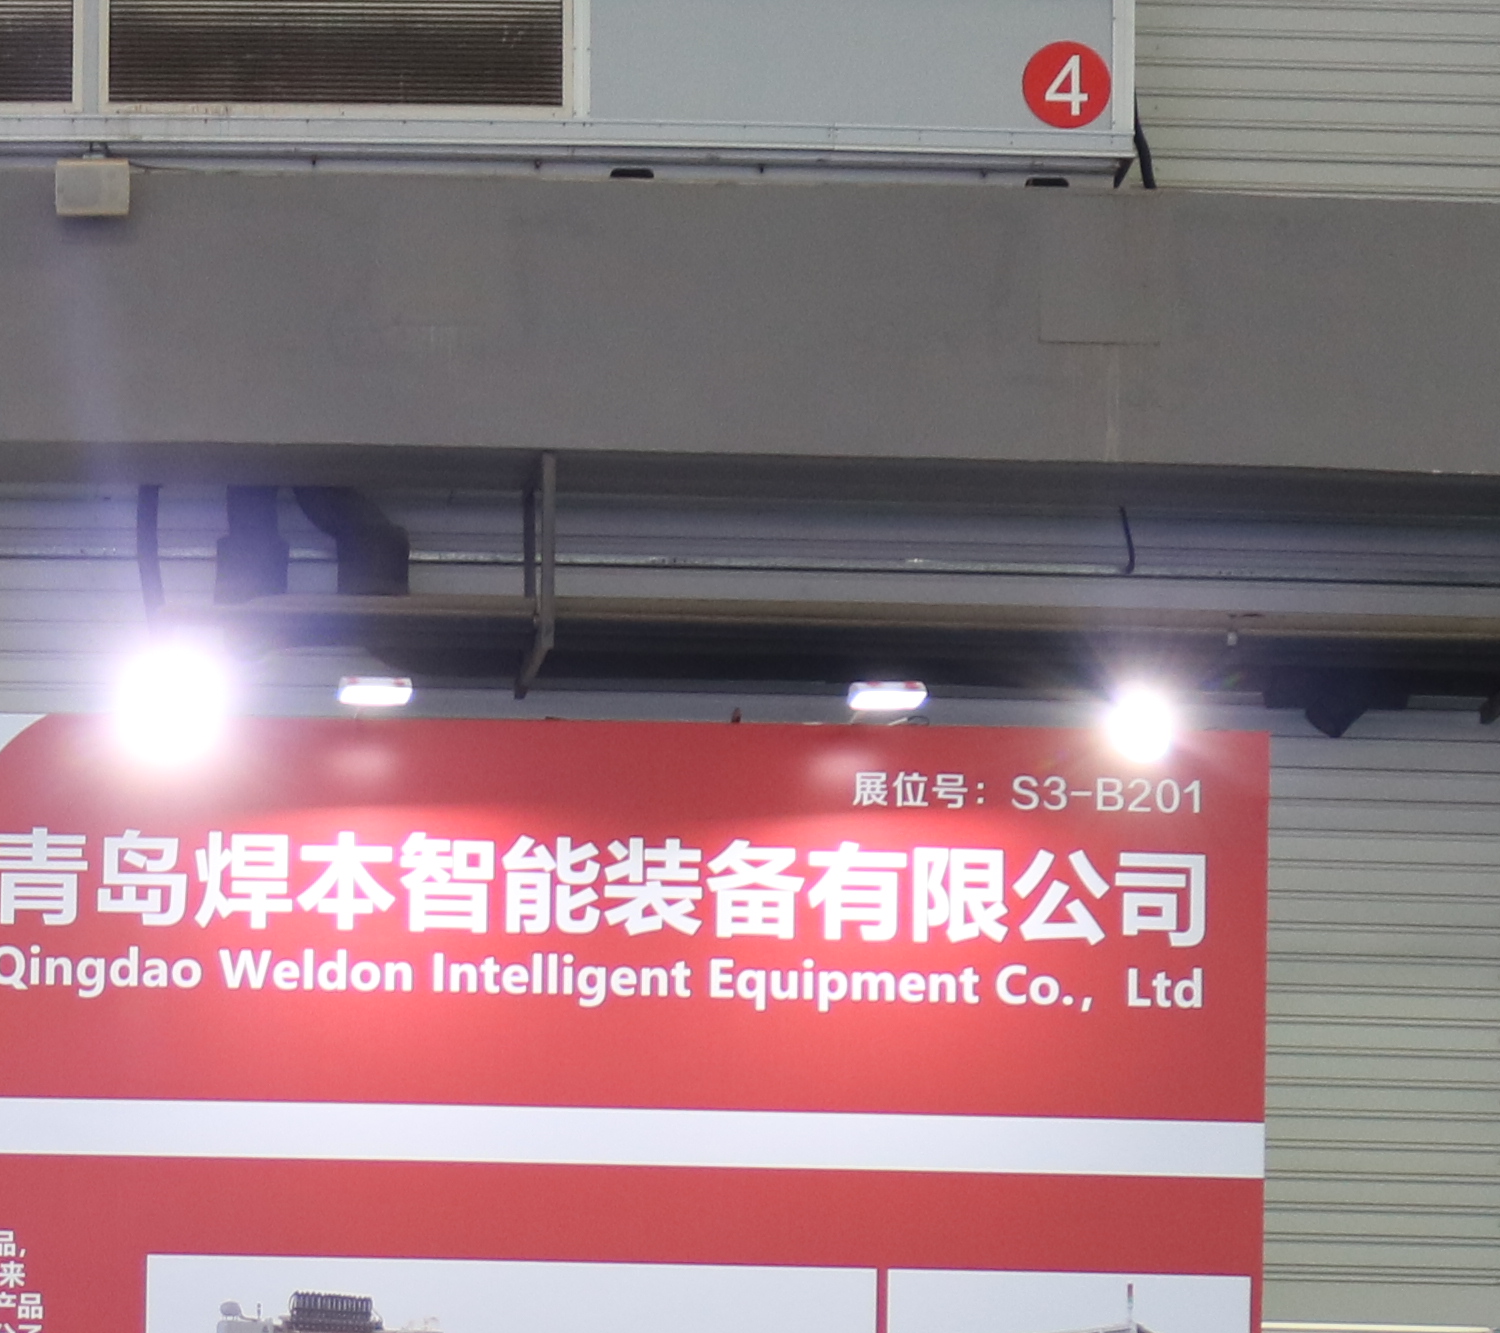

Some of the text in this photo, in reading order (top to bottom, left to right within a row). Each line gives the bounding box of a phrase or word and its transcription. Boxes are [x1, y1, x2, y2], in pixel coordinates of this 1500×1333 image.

[1045, 54, 1088, 116] 4
[219, 948, 413, 992] Weldon
[432, 952, 692, 1008] Intelligent
[709, 957, 980, 1013] Equipment
[1126, 966, 1204, 1010] Ltd
